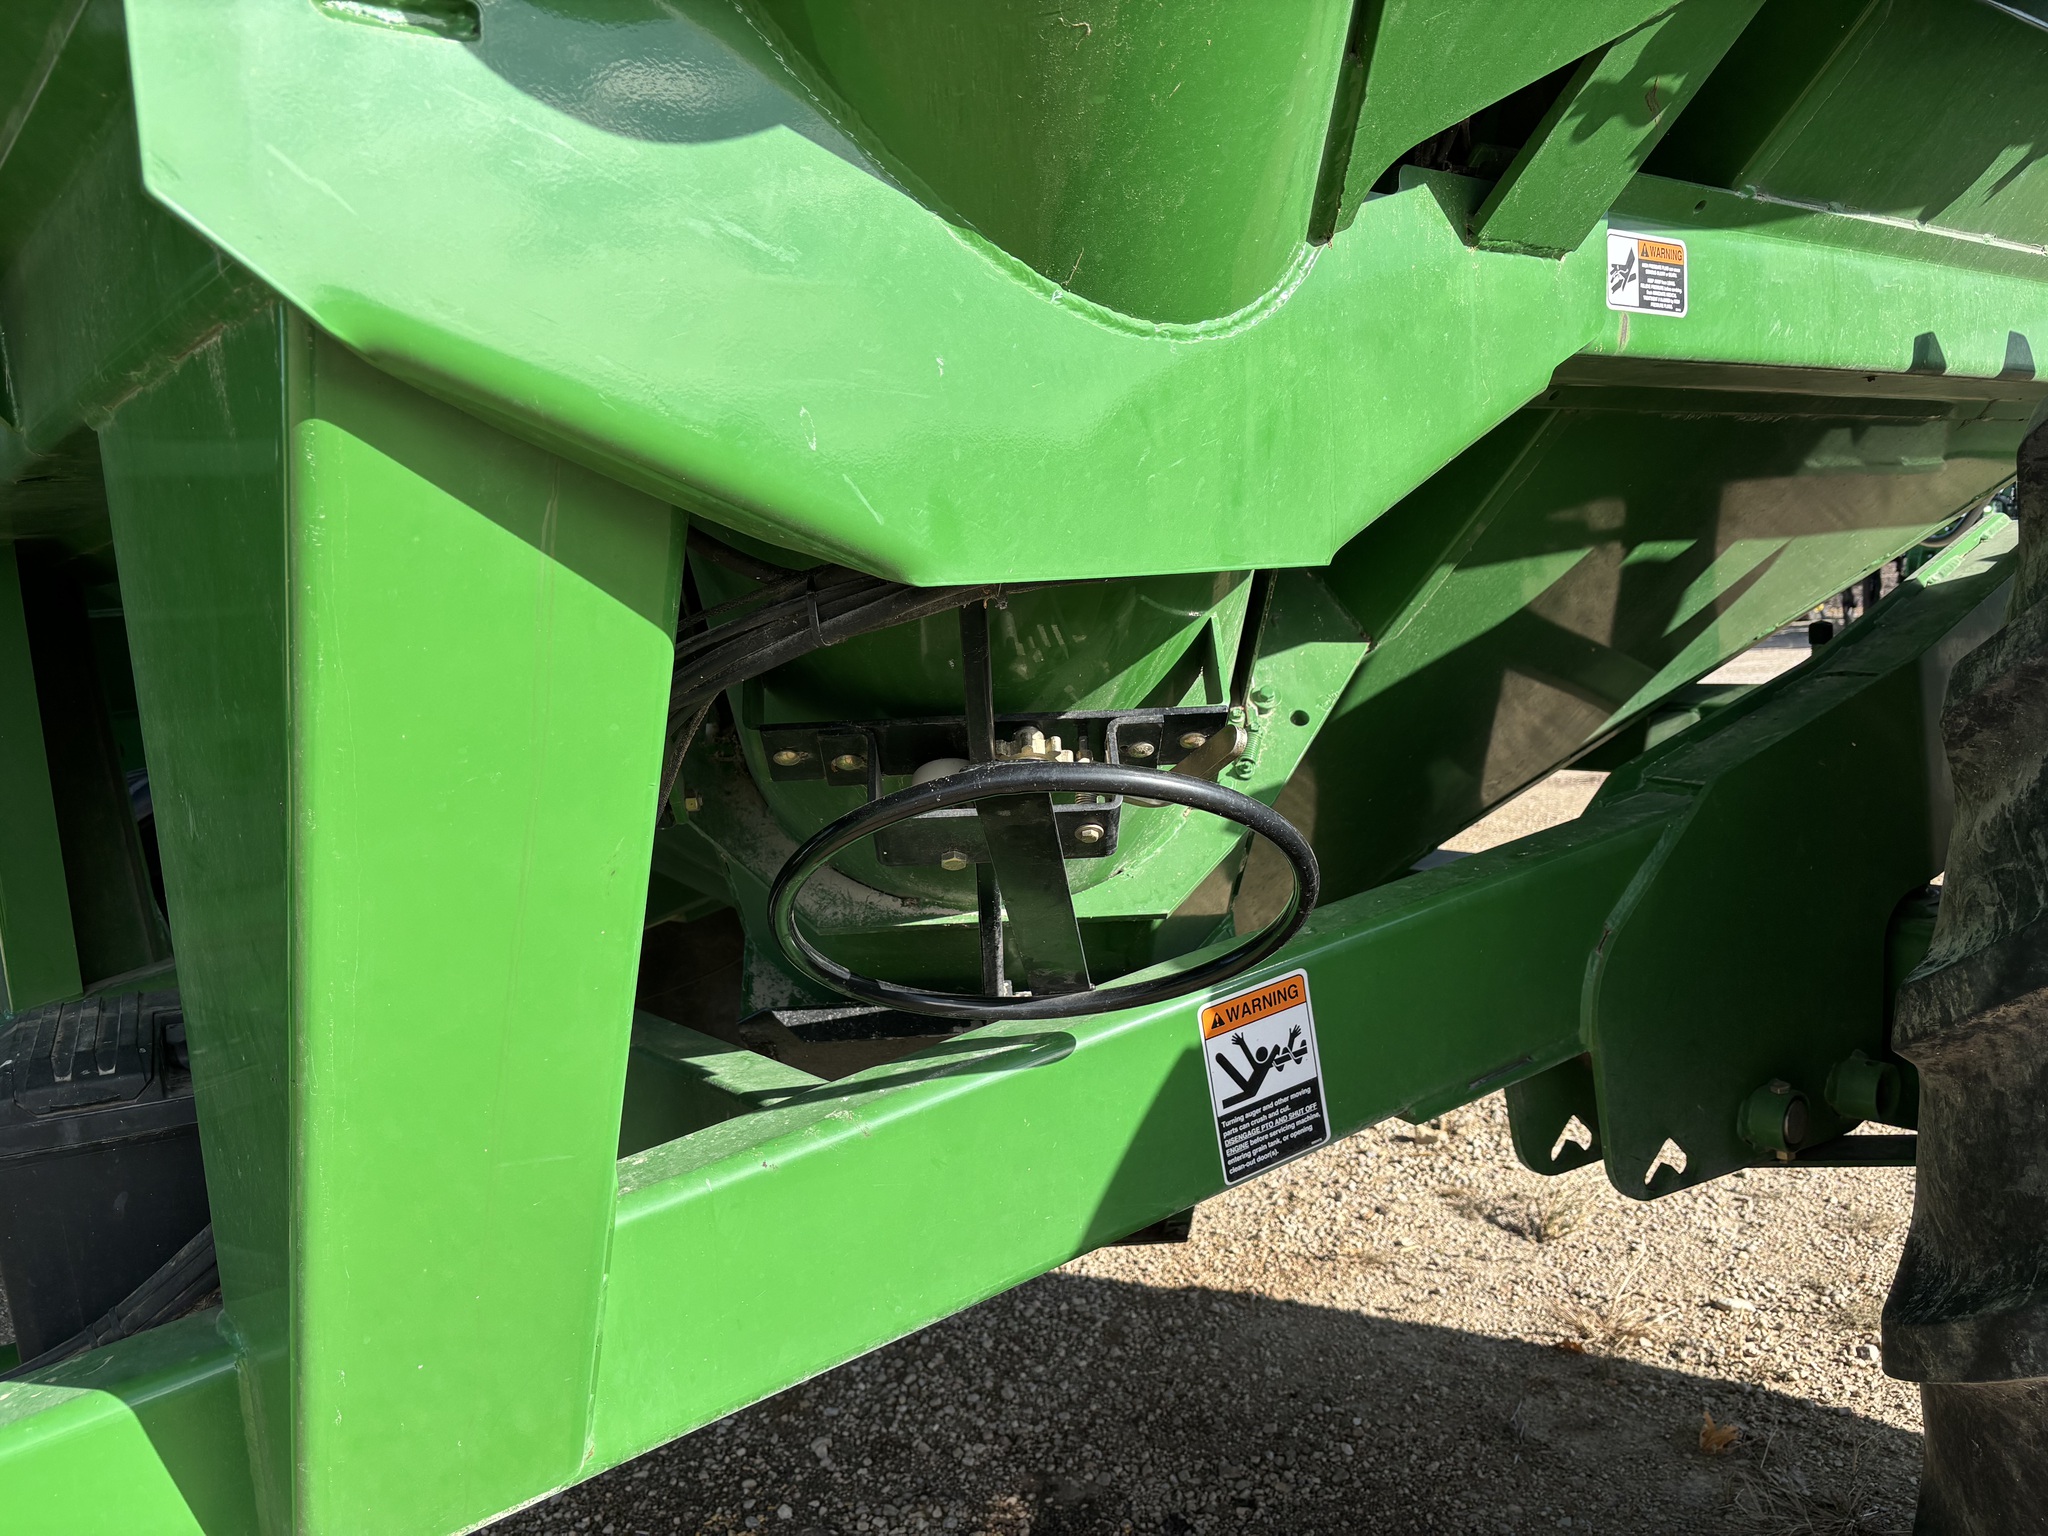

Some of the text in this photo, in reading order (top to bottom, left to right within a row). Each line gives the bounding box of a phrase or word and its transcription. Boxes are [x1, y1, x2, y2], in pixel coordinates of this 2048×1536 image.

[1650, 246, 1682, 261] WARNING
[1226, 984, 1299, 1022] WARNING
[1221, 1087, 1311, 1128] Turning auger and other moving
[1222, 1128, 1238, 1139] parts
[1251, 1115, 1267, 1126] crush
[1268, 1109, 1279, 1119] and
[1280, 1105, 1291, 1114] cut.
[1225, 1102, 1317, 1147] DISENGAGE PTO AND SHUT OFF
[1226, 1112, 1320, 1157] ENGINE before servicing machine,
[1227, 1149, 1252, 1165] entering
[1252, 1143, 1267, 1155] grain
[1268, 1138, 1282, 1147] tank,
[1290, 1124, 1313, 1138] opening
[1229, 1149, 1279, 1174] clean-out door(s).
